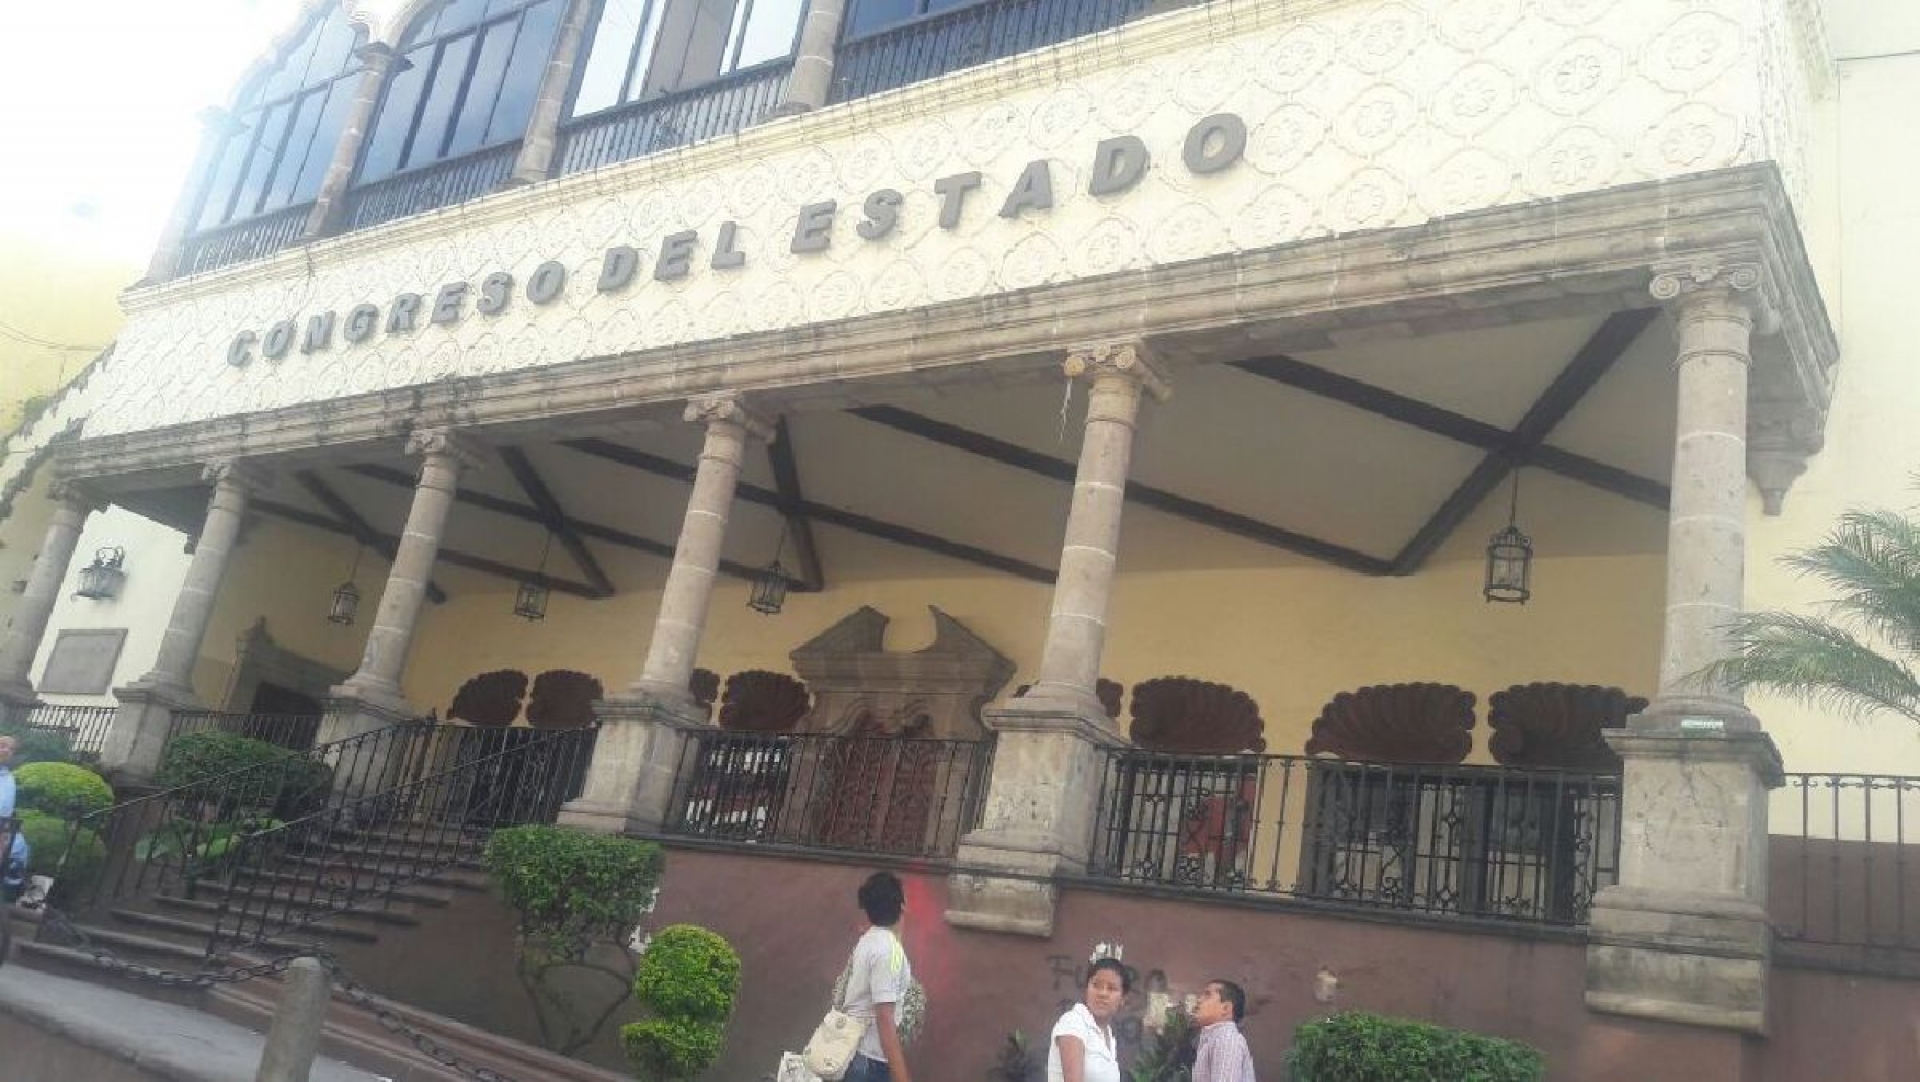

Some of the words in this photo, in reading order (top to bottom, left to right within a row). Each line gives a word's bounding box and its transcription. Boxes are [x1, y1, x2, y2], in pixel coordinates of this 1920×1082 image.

[227, 260, 566, 367] CONGRESO
[597, 220, 746, 295] DEL
[790, 113, 1247, 254] ESTADO
